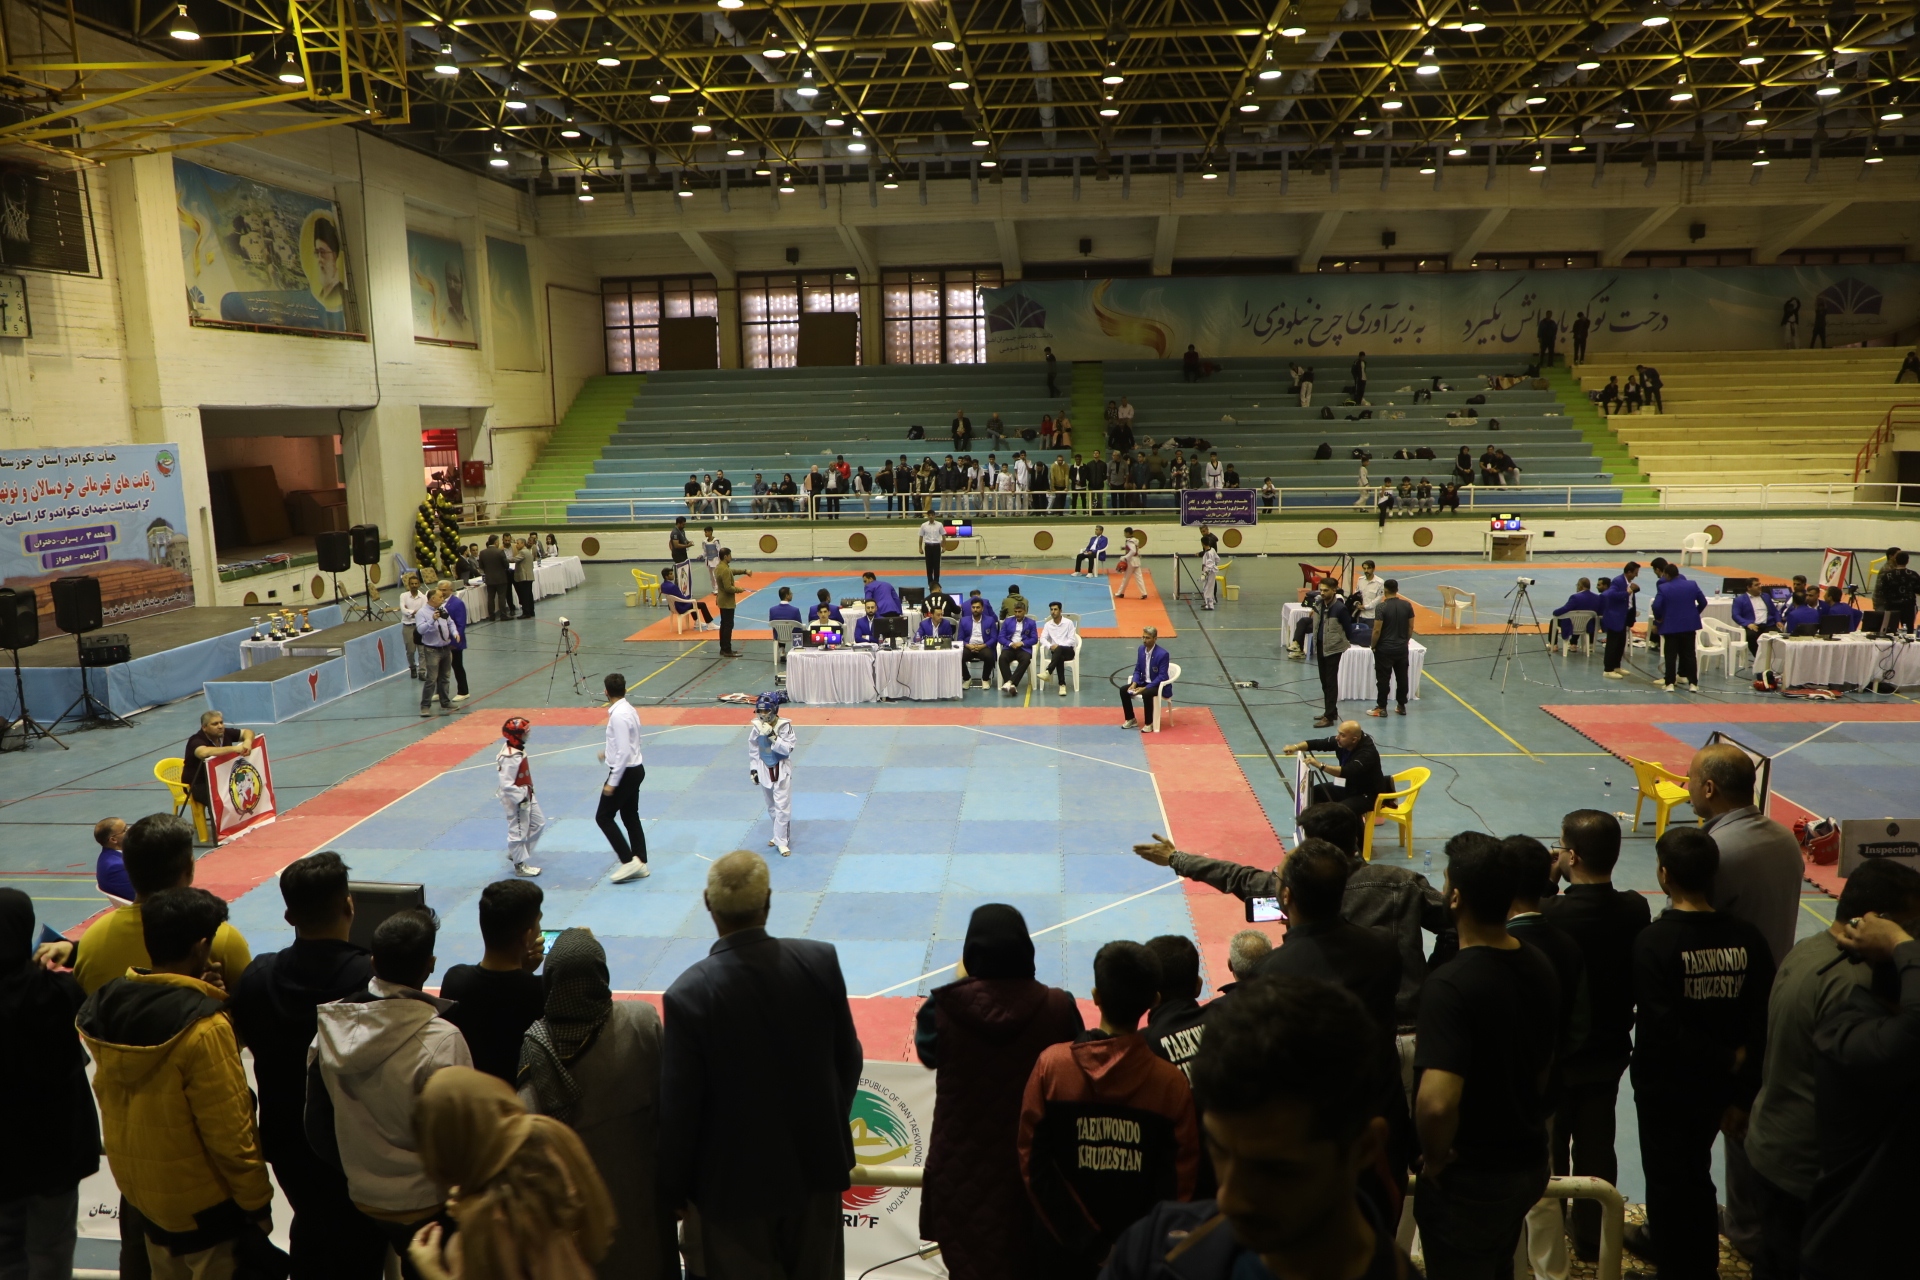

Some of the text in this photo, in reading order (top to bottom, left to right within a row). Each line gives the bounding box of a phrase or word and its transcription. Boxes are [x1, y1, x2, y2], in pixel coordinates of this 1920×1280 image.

[1242, 299, 1254, 328] را
[1253, 297, 1313, 345] نیلوفری
[1346, 302, 1399, 335] آوری
[1462, 276, 1526, 344] بگیرد
[1501, 293, 1541, 343] انش
[1609, 293, 1669, 333] درخت
[1307, 303, 1344, 347] چرخ
[1388, 304, 1415, 344] زیر
[1413, 325, 1426, 344] به
[0, 455, 33, 470] خوزستا
[37, 454, 61, 469] استان
[65, 452, 95, 467] تکواندو
[31, 477, 75, 502] خردسالان
[78, 473, 111, 498] قهرمانی
[114, 474, 130, 494] های
[132, 471, 155, 491] رقابت
[22, 487, 28, 504] و
[5, 499, 150, 525] گرامیداشت شهدای تکواندو کار استان
[1494, 521, 1517, 529] 0 0
[55, 554, 72, 565] اهواز
[79, 549, 100, 560] آذرماه
[102, 604, 119, 617] خوزستا
[1864, 845, 1919, 856] Inspection
[1681, 946, 1748, 975] TAEKWONDO
[1160, 1023, 1206, 1063] TAEKW
[858, 1078, 890, 1096] EPUBLIC
[889, 1093, 899, 1103] OF
[897, 1100, 913, 1119] IRAN
[1076, 1116, 1141, 1144] TAEKWONDO
[1078, 1144, 1143, 1172] KHUZESTAN
[88, 1203, 118, 1218] زستان
[886, 1187, 912, 1214] RATION
